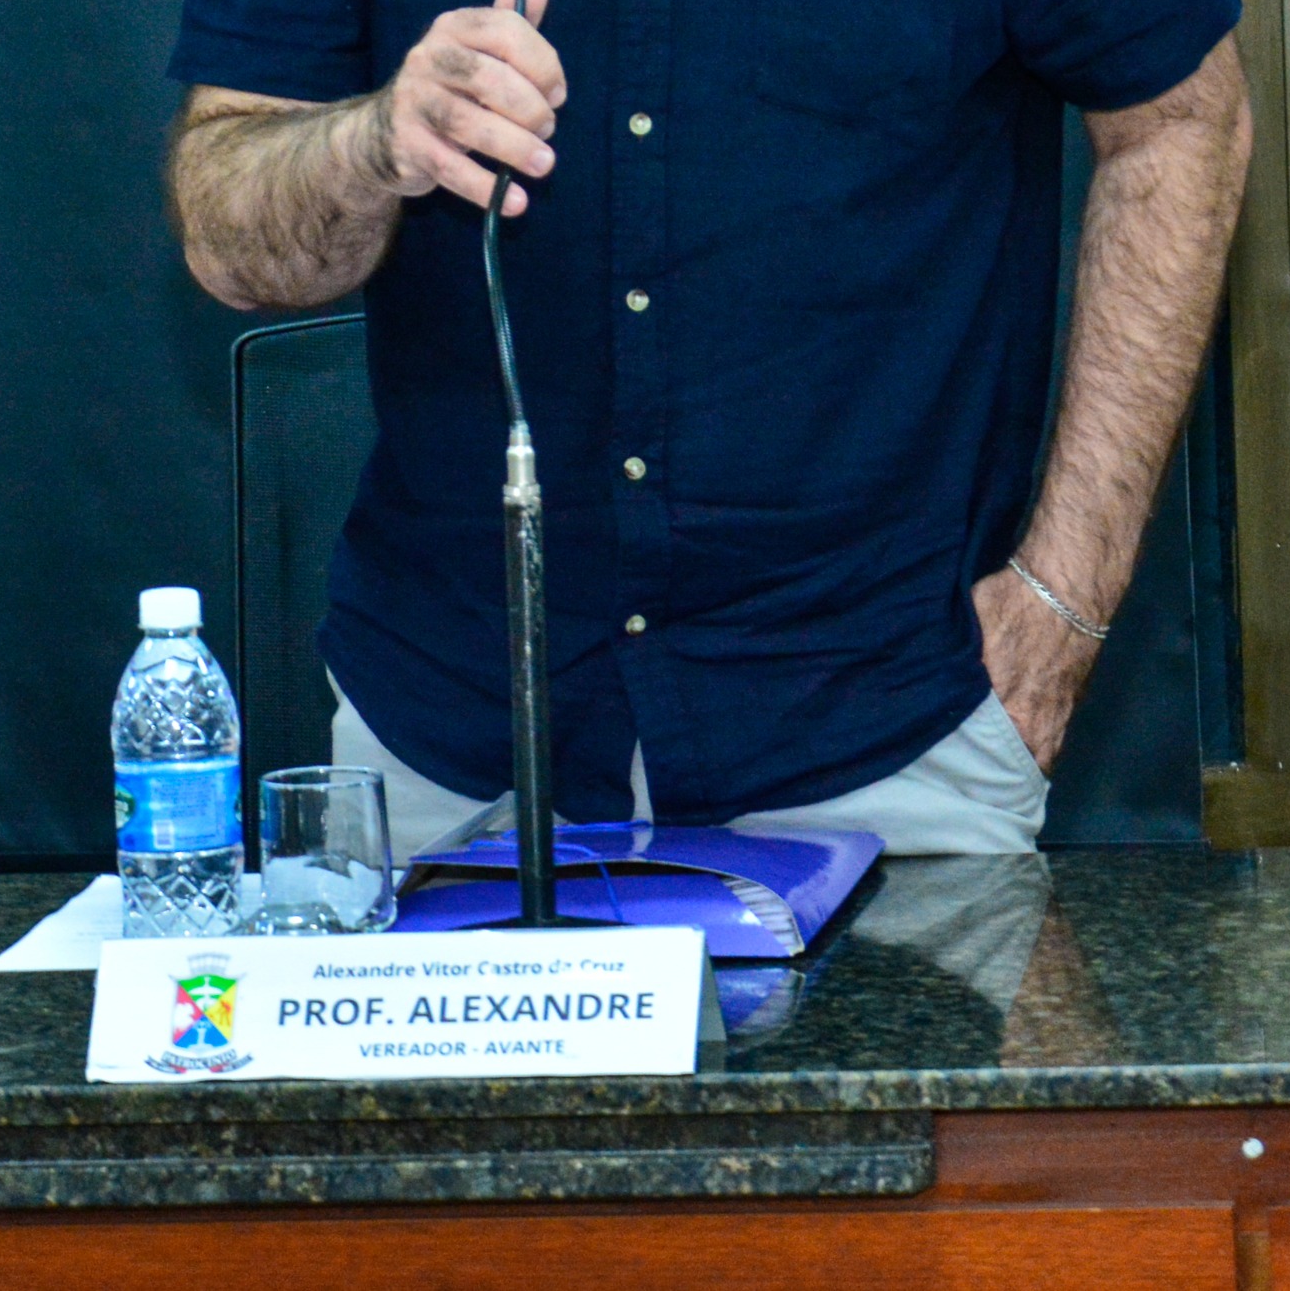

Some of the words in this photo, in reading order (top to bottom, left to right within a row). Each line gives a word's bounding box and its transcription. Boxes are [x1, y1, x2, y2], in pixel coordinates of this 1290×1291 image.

[313, 963, 416, 979] Alexandre
[422, 963, 471, 977] Vitor
[477, 960, 543, 976] Castro
[279, 998, 393, 1025] PROF.
[408, 993, 653, 1023] ALEXANDRE
[359, 1041, 466, 1058] VEREADOR
[484, 1039, 563, 1055] AVANTE
